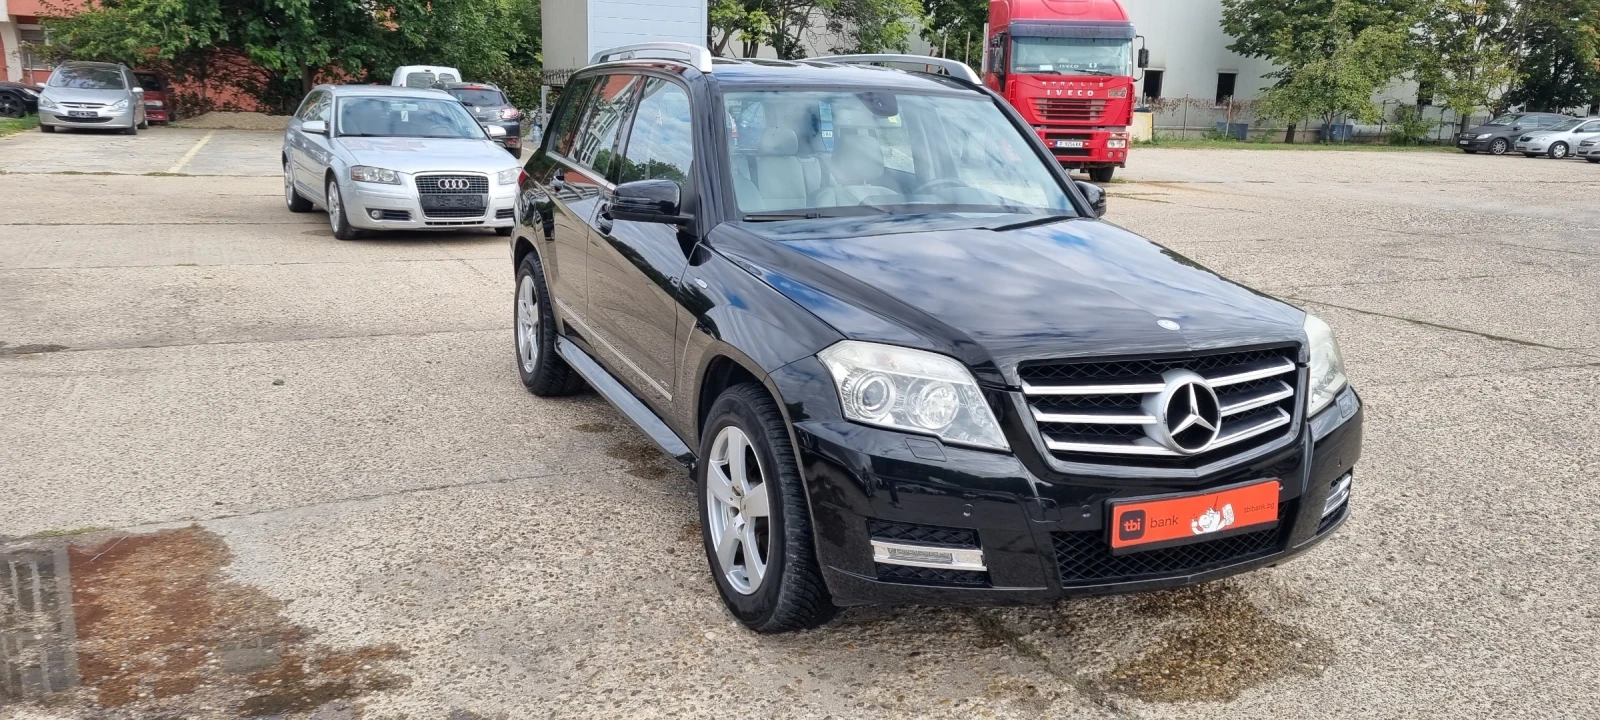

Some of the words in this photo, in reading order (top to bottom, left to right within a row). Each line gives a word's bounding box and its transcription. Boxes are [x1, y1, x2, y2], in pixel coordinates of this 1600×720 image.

[1244, 502, 1275, 514] tbibank.bg
[1124, 519, 1141, 532] tbi
[1150, 515, 1179, 529] bank
